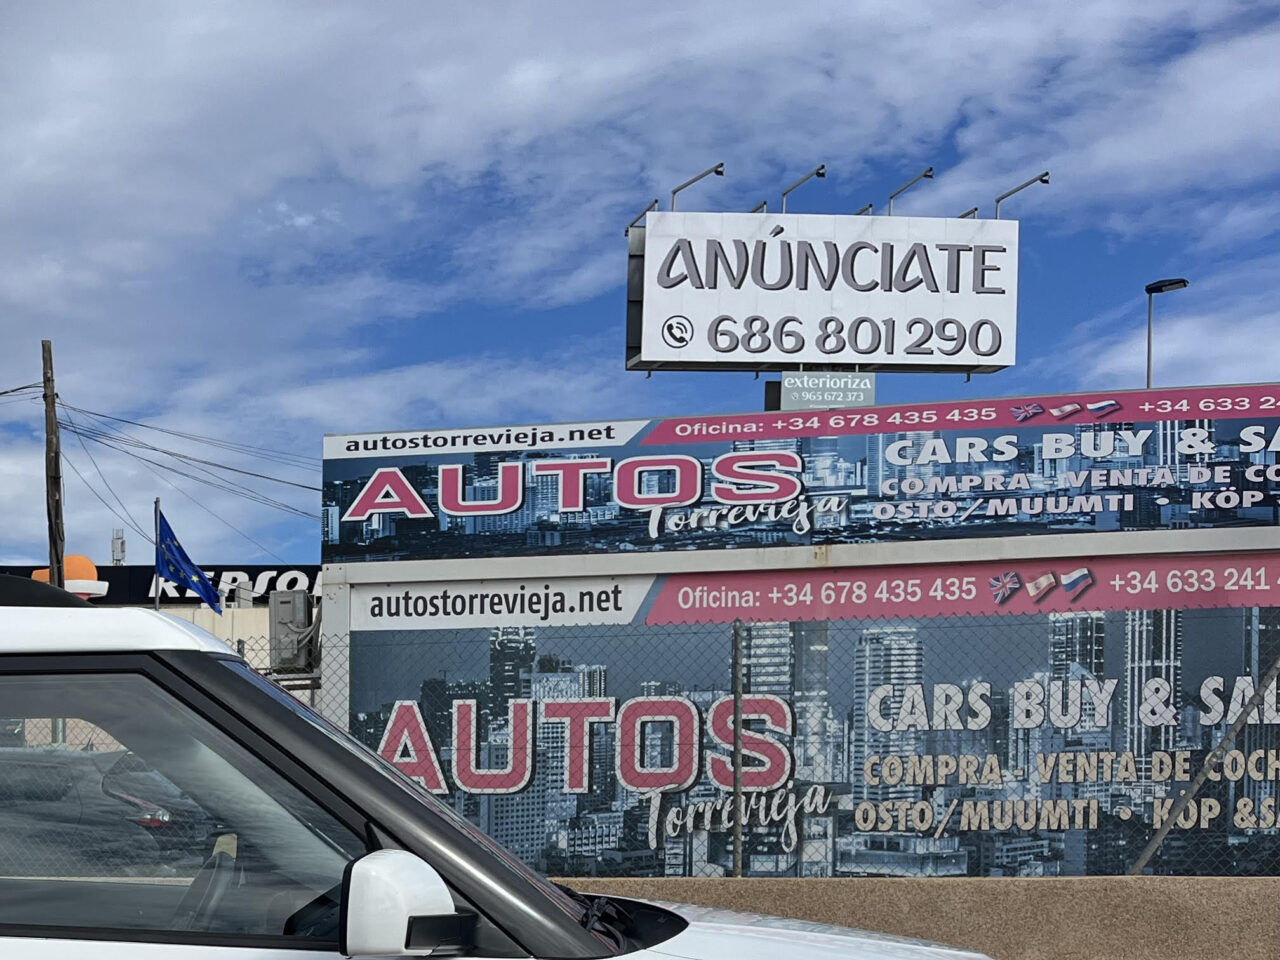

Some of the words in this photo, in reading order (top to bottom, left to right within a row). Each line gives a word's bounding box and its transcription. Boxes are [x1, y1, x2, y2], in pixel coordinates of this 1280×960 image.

[657, 224, 1007, 294] ANÚNCIATE
[707, 314, 805, 354] 686
[815, 316, 895, 355] 801
[903, 317, 1002, 357] 290
[784, 374, 872, 389] exterioriza
[801, 391, 822, 401] 965
[824, 391, 843, 401] 672
[846, 391, 864, 402] 373
[675, 421, 764, 437] Oficina:
[772, 415, 820, 431] +34
[829, 413, 879, 429] 678
[886, 410, 938, 425] 435
[945, 407, 998, 422] 435
[1138, 399, 1190, 413] +34
[1199, 397, 1250, 411] 633
[1259, 396, 1280, 409] 2
[345, 424, 616, 453] autostorrevieja.net
[885, 434, 1019, 467] CARS
[1041, 428, 1154, 460] BUY
[1175, 427, 1217, 455] &
[341, 450, 805, 522] AUTOS
[881, 473, 1031, 497] COMPRA
[1067, 468, 1176, 489] VENTA
[1189, 465, 1232, 484] DE
[1191, 486, 1264, 509] KÖP
[637, 492, 849, 539] Torrevieja
[678, 585, 761, 609] Oficina:
[768, 583, 813, 606] +34
[821, 581, 868, 605] 678
[874, 579, 922, 603] 435
[929, 577, 977, 601] 435
[1109, 570, 1159, 595] +34
[1166, 568, 1216, 593] 633
[1223, 566, 1270, 591] 241
[370, 583, 623, 621] autostorrevieja.net
[867, 681, 992, 732] CARS
[1013, 678, 1119, 729] BUY
[1139, 677, 1178, 727] &
[377, 693, 798, 795] AUTOS
[863, 753, 1003, 786] COMPRA
[1035, 751, 1138, 784] VENTA
[1151, 750, 1191, 781] DE
[638, 780, 834, 853] Torrevieja
